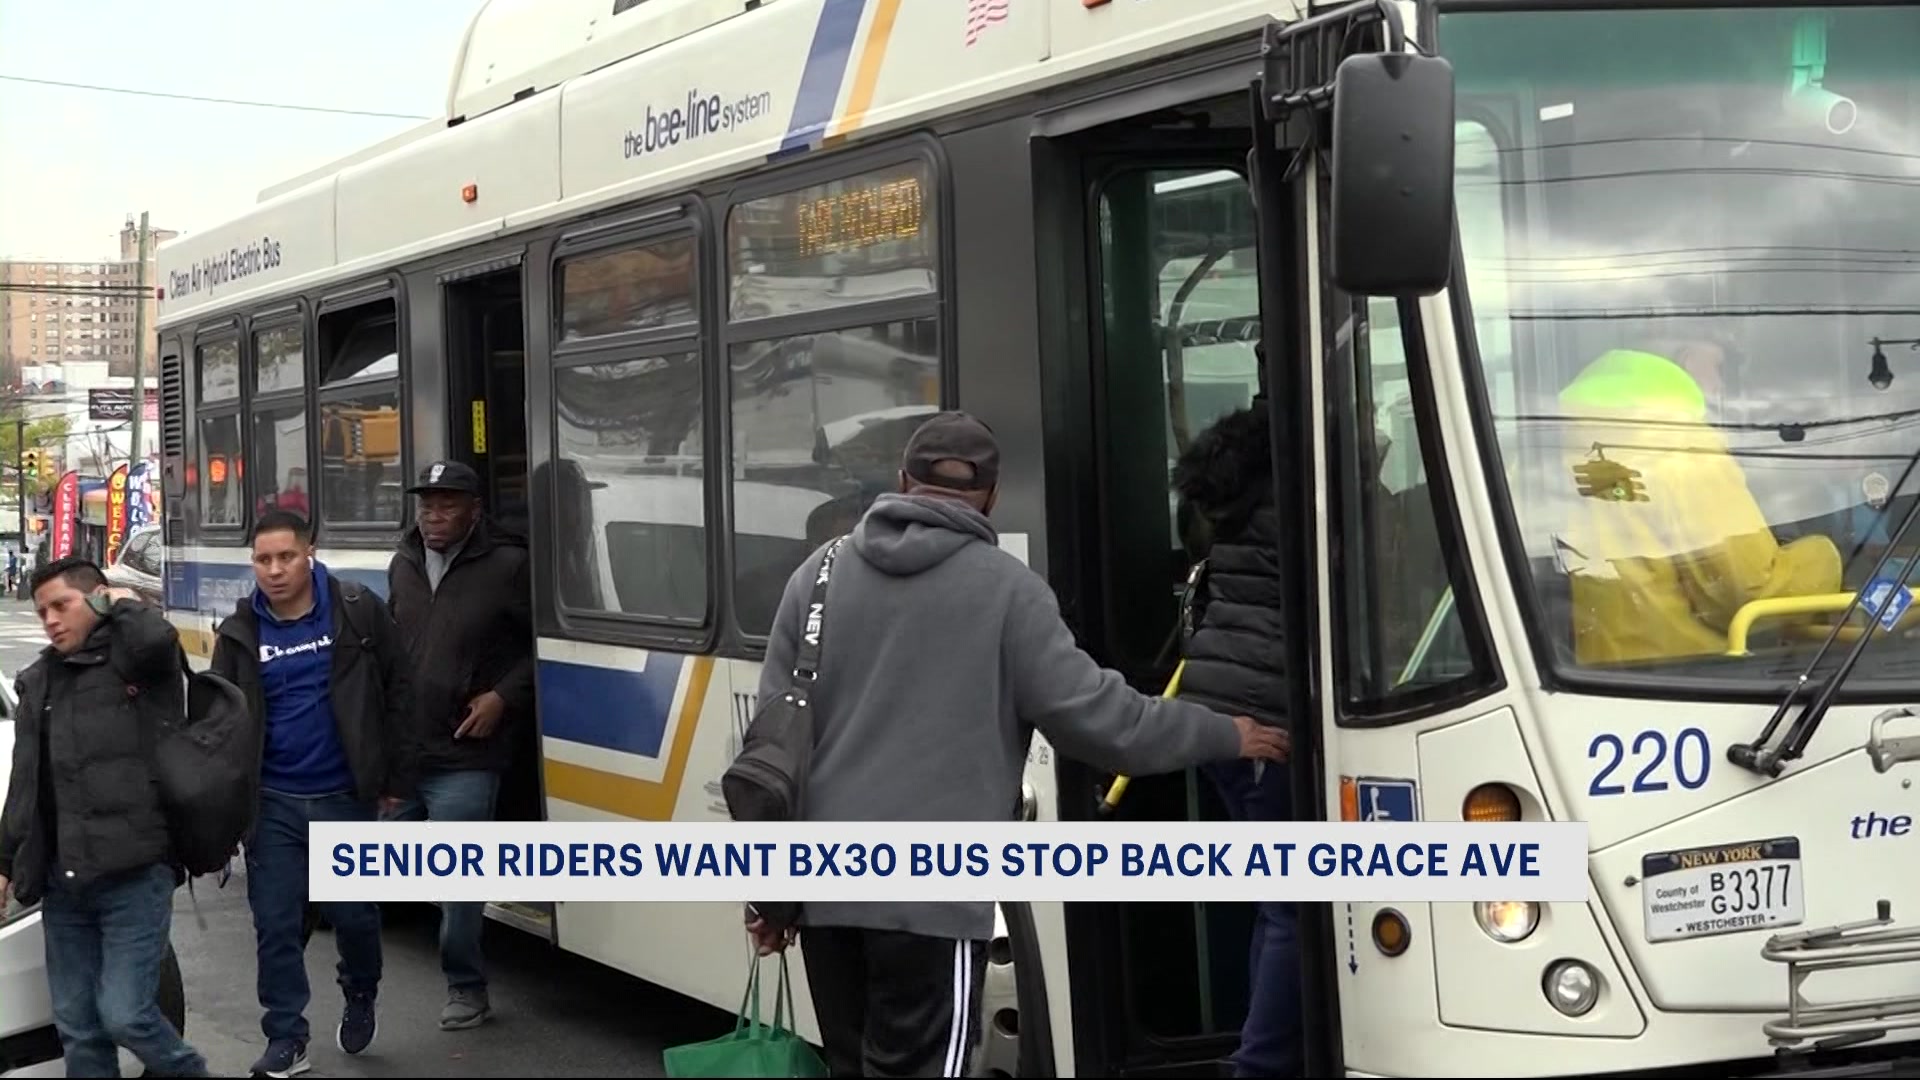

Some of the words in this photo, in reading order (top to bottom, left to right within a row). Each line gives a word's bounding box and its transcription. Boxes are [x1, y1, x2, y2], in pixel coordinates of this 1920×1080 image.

[624, 131, 643, 159] the
[645, 88, 720, 152] bee-line
[722, 91, 770, 132] system
[169, 270, 190, 300] Clean
[191, 262, 202, 293] Air
[203, 251, 228, 296] Hybrid
[230, 241, 261, 281] Electric
[263, 236, 281, 270] Bus
[259, 635, 333, 663] Champ
[1587, 727, 1711, 797] 220
[1851, 811, 1912, 839] the
[1681, 852, 1718, 868] NEW
[1721, 846, 1762, 862] YORK
[1656, 887, 1687, 899] County
[1690, 885, 1699, 895] of
[1729, 865, 1791, 912] 3377
[1651, 899, 1706, 914] Westchester
[1686, 914, 1766, 932] WESTCHESTER
